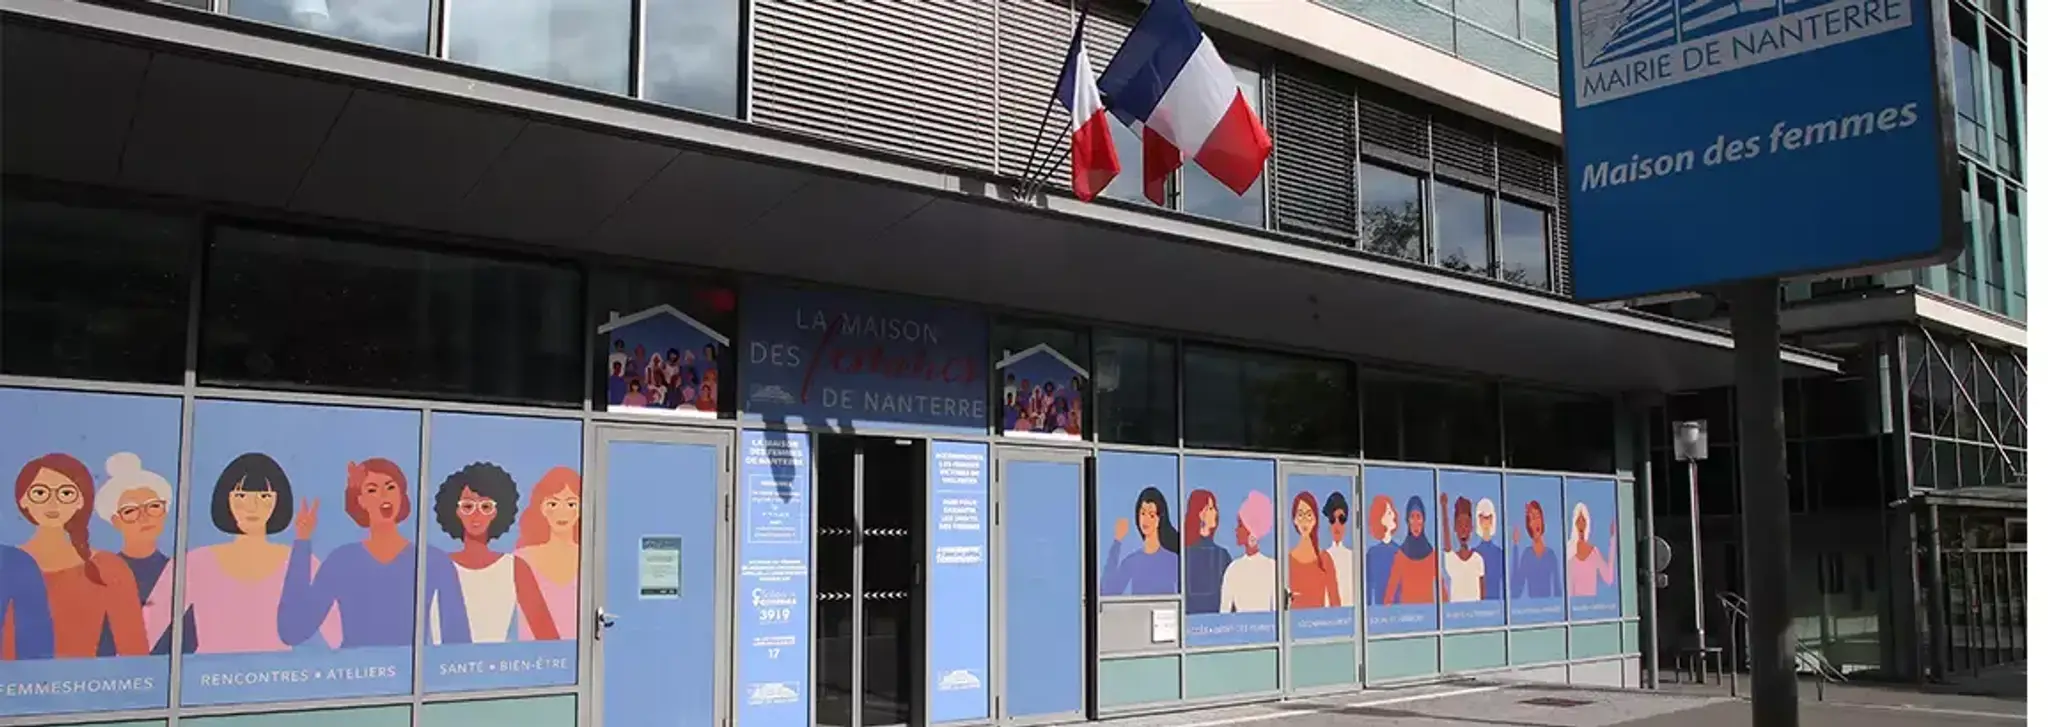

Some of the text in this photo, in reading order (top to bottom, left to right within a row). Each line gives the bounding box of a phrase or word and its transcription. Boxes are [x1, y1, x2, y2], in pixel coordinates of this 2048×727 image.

[1582, 1, 1901, 98] MAIRIE DE NANTERRE
[1581, 101, 1919, 192] Maison des femmes
[796, 307, 938, 345] LA MAISON
[750, 341, 801, 367] DES
[823, 388, 985, 419] DE NANTERRE
[759, 608, 790, 620] 3919
[499, 656, 568, 673] BIEN-ÊTRE
[768, 648, 780, 659] 17
[200, 665, 396, 688] RENCONTRES ATELIERS
